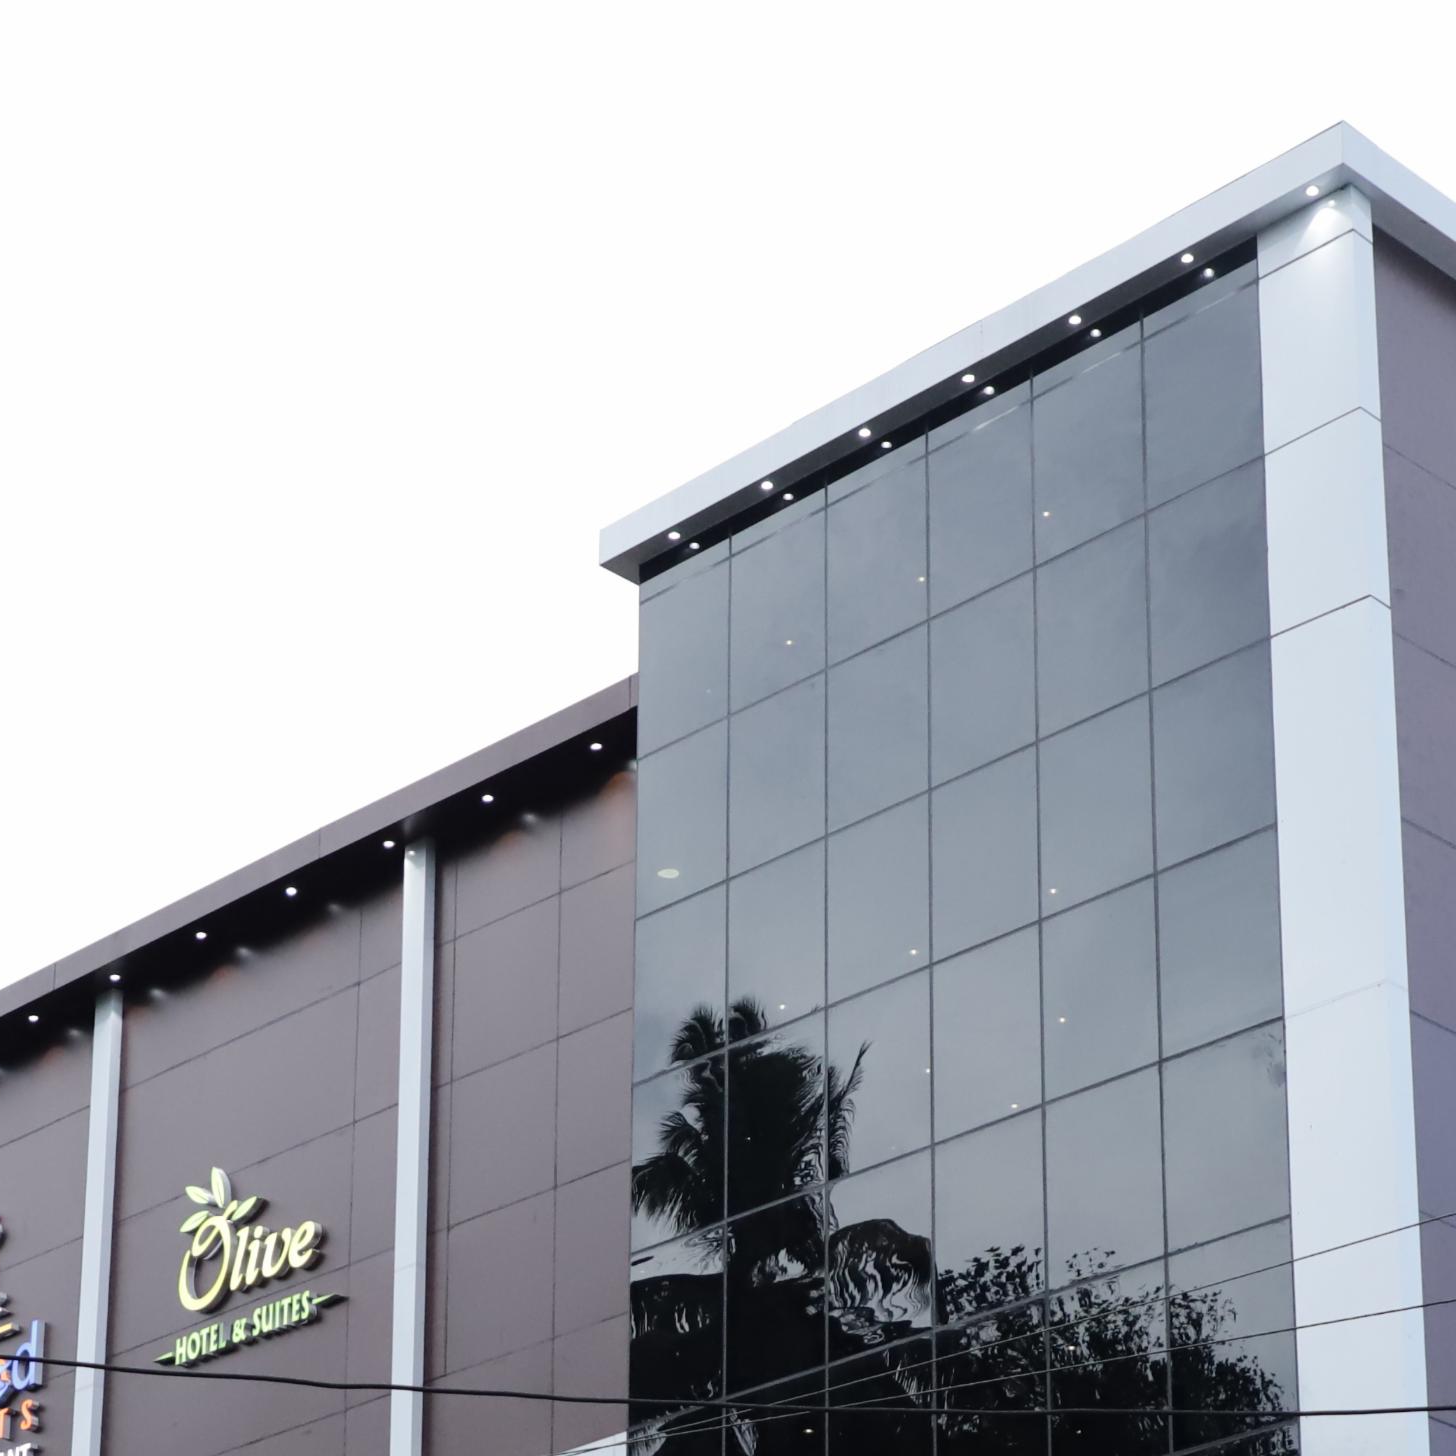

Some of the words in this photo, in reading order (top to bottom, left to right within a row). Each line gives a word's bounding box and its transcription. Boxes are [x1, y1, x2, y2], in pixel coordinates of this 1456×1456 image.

[178, 1213, 320, 1312] Olive
[174, 1321, 227, 1366] HOTEL
[232, 1317, 248, 1343] &
[251, 1290, 312, 1336] SUITES
